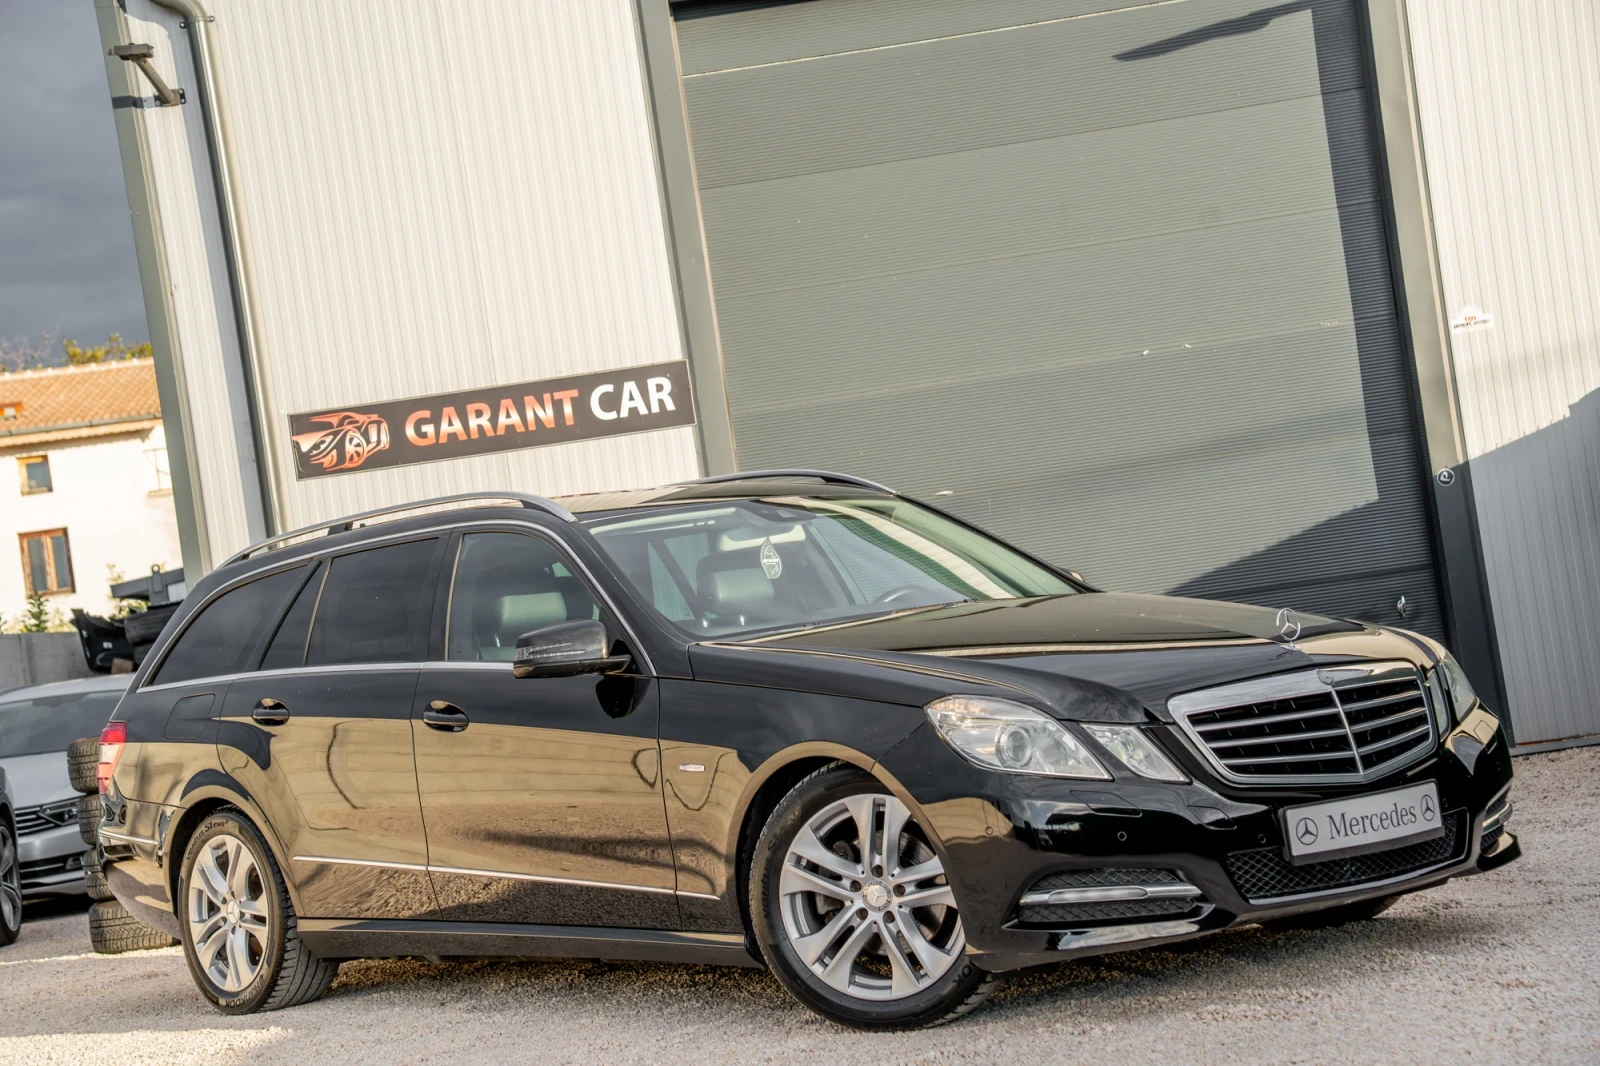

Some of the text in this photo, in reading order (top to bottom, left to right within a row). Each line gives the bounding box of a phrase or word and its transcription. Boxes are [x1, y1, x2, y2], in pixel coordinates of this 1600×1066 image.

[405, 376, 676, 446] GARANT CAR
[1326, 803, 1417, 840] Mercedes
